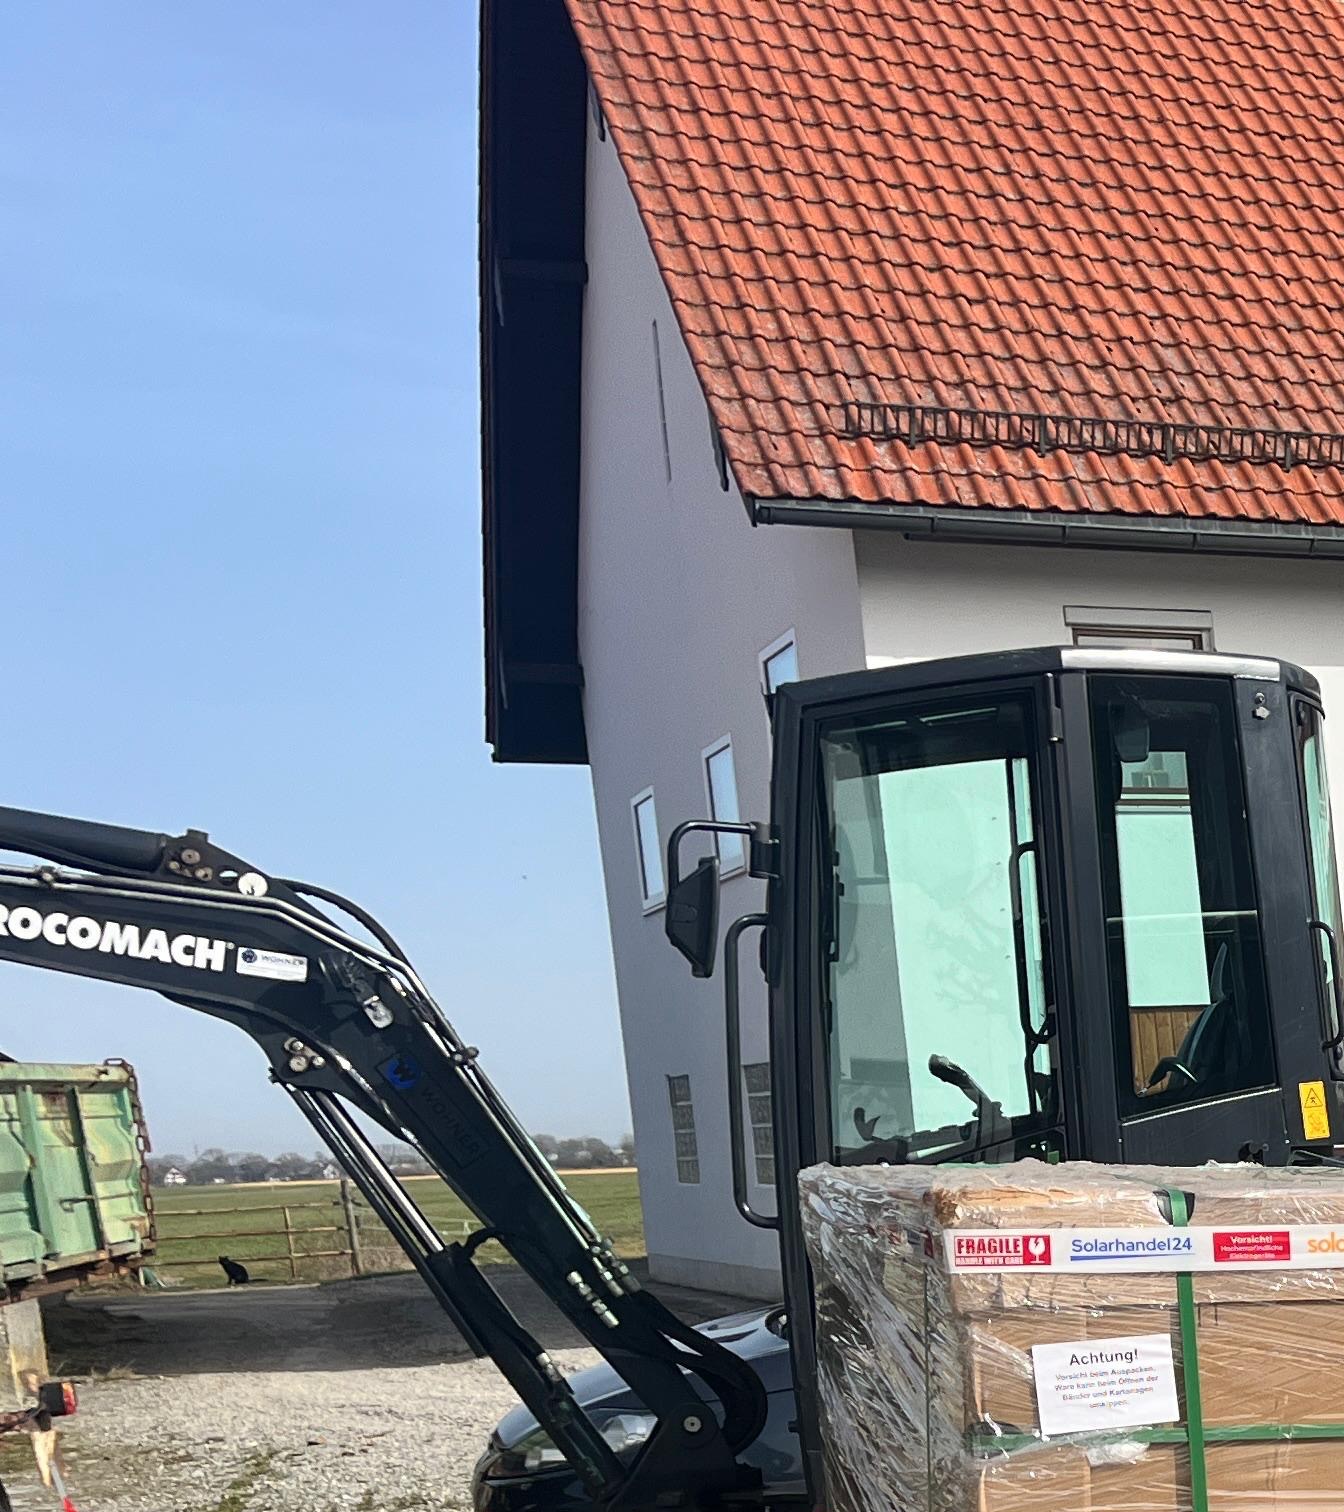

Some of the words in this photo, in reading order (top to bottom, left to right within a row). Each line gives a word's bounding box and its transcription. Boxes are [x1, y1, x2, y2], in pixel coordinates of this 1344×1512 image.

[0, 903, 227, 972] OCOMACH
[957, 1238, 1020, 1254] FRAGILE
[1072, 1237, 1192, 1253] Solarhandel24
[1069, 1348, 1139, 1366] Achtung!
